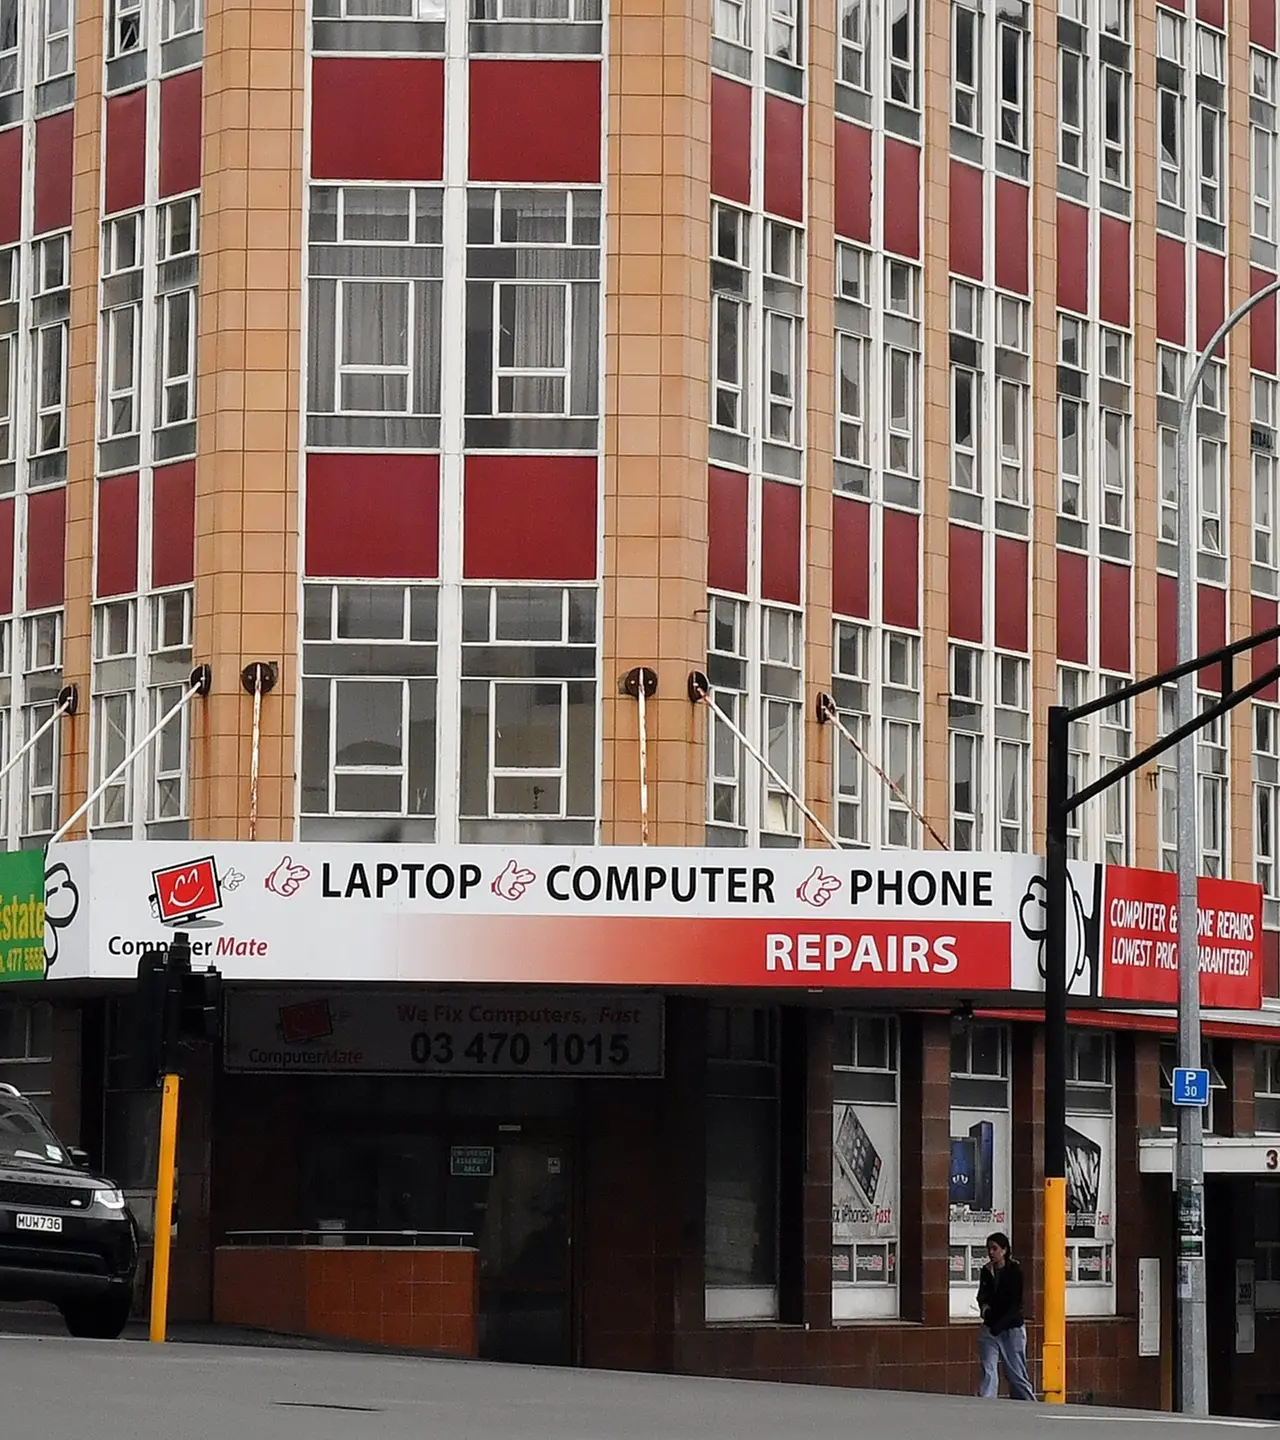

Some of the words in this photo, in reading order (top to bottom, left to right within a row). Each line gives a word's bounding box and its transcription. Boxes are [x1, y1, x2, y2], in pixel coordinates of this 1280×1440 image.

[321, 862, 483, 901] LAPTOP
[546, 864, 776, 904] COMPUTER
[850, 869, 993, 906] PHONE
[1110, 898, 1166, 932] COMPUTER
[1169, 904, 1177, 934] &
[1217, 911, 1254, 941] REPAIRS
[216, 936, 268, 957] Mate
[765, 933, 959, 974] REPAIRS
[1112, 937, 1152, 967] LOWEST
[1155, 941, 1178, 970] PRIC
[397, 1004, 428, 1022] We
[434, 1005, 463, 1021] Fix
[470, 1005, 587, 1026] Computers,
[600, 1006, 641, 1023] Fast
[411, 1032, 454, 1064] 03
[465, 1033, 531, 1065] 470
[544, 1033, 629, 1065] 1015
[1185, 1072, 1196, 1085] P
[1184, 1086, 1197, 1097] 30
[17, 1215, 61, 1231] MUW736
[874, 1205, 892, 1224] Fast
